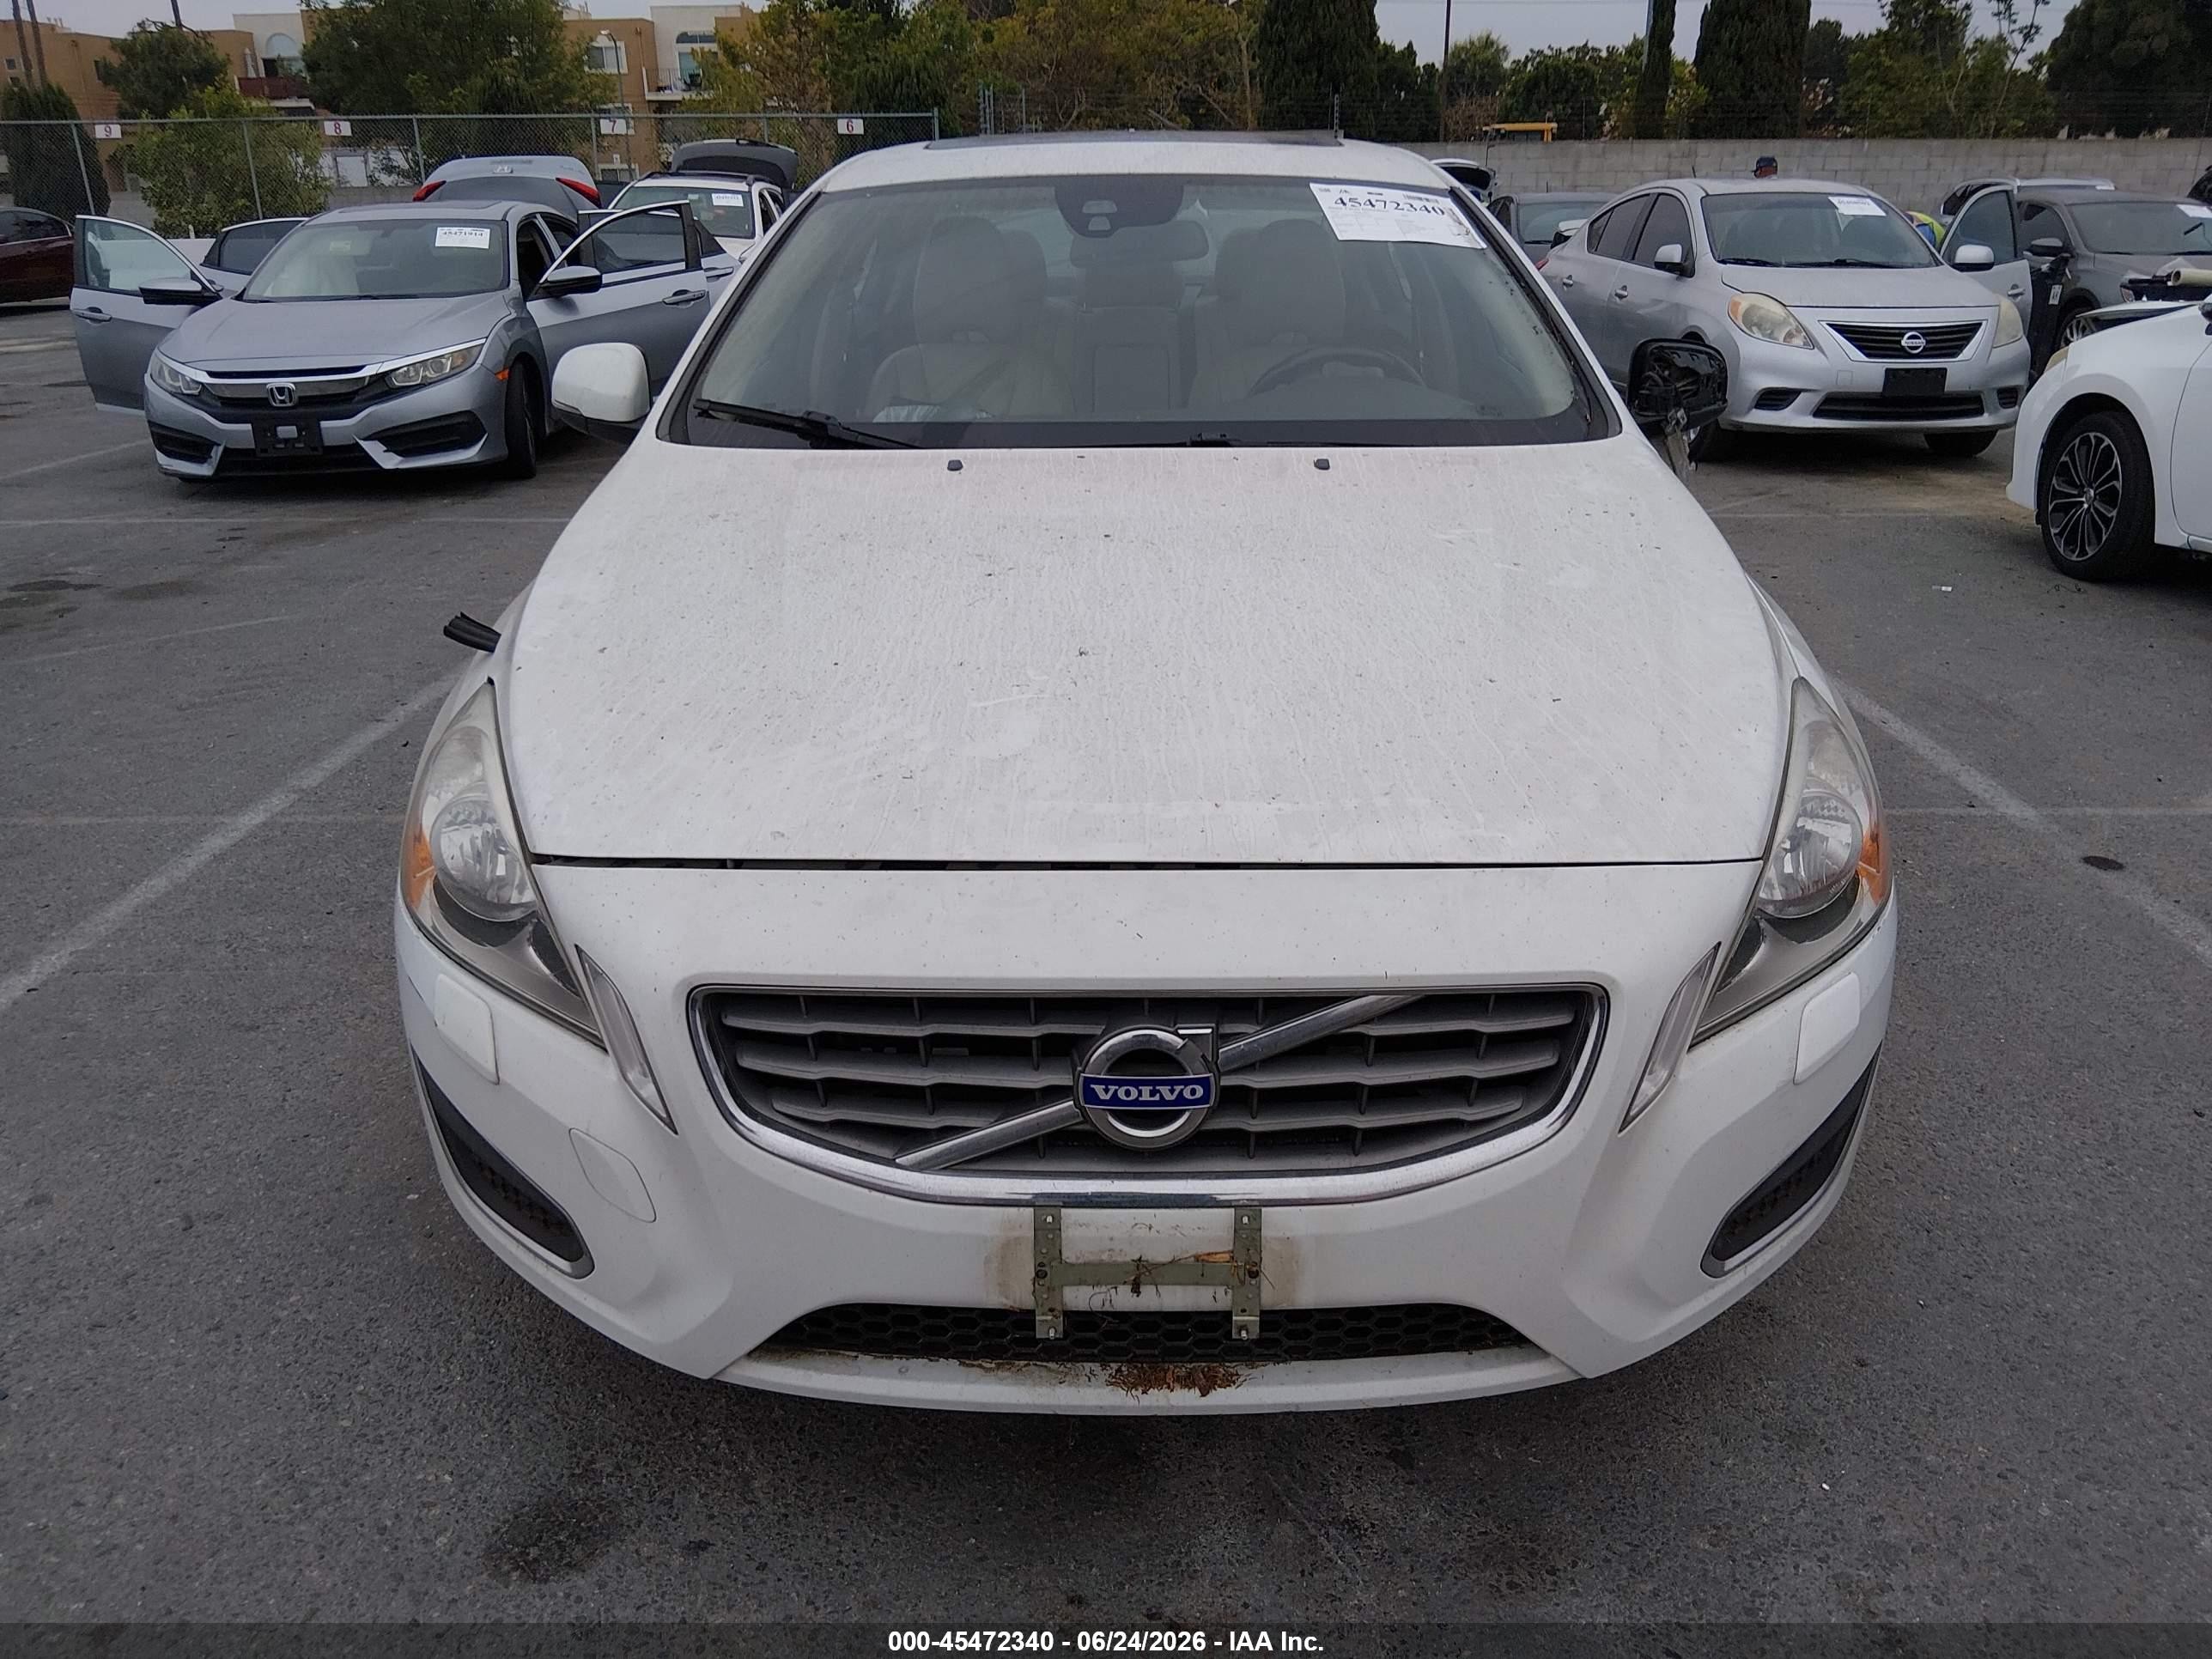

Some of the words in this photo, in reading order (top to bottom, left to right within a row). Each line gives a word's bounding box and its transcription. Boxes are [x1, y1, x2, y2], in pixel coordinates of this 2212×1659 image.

[104, 125, 112, 137] 9
[334, 121, 342, 135] 8
[609, 118, 617, 133] 7
[847, 120, 854, 133] 6
[1334, 197, 1445, 216] 45472340
[1090, 1085, 1204, 1101] VOLVO
